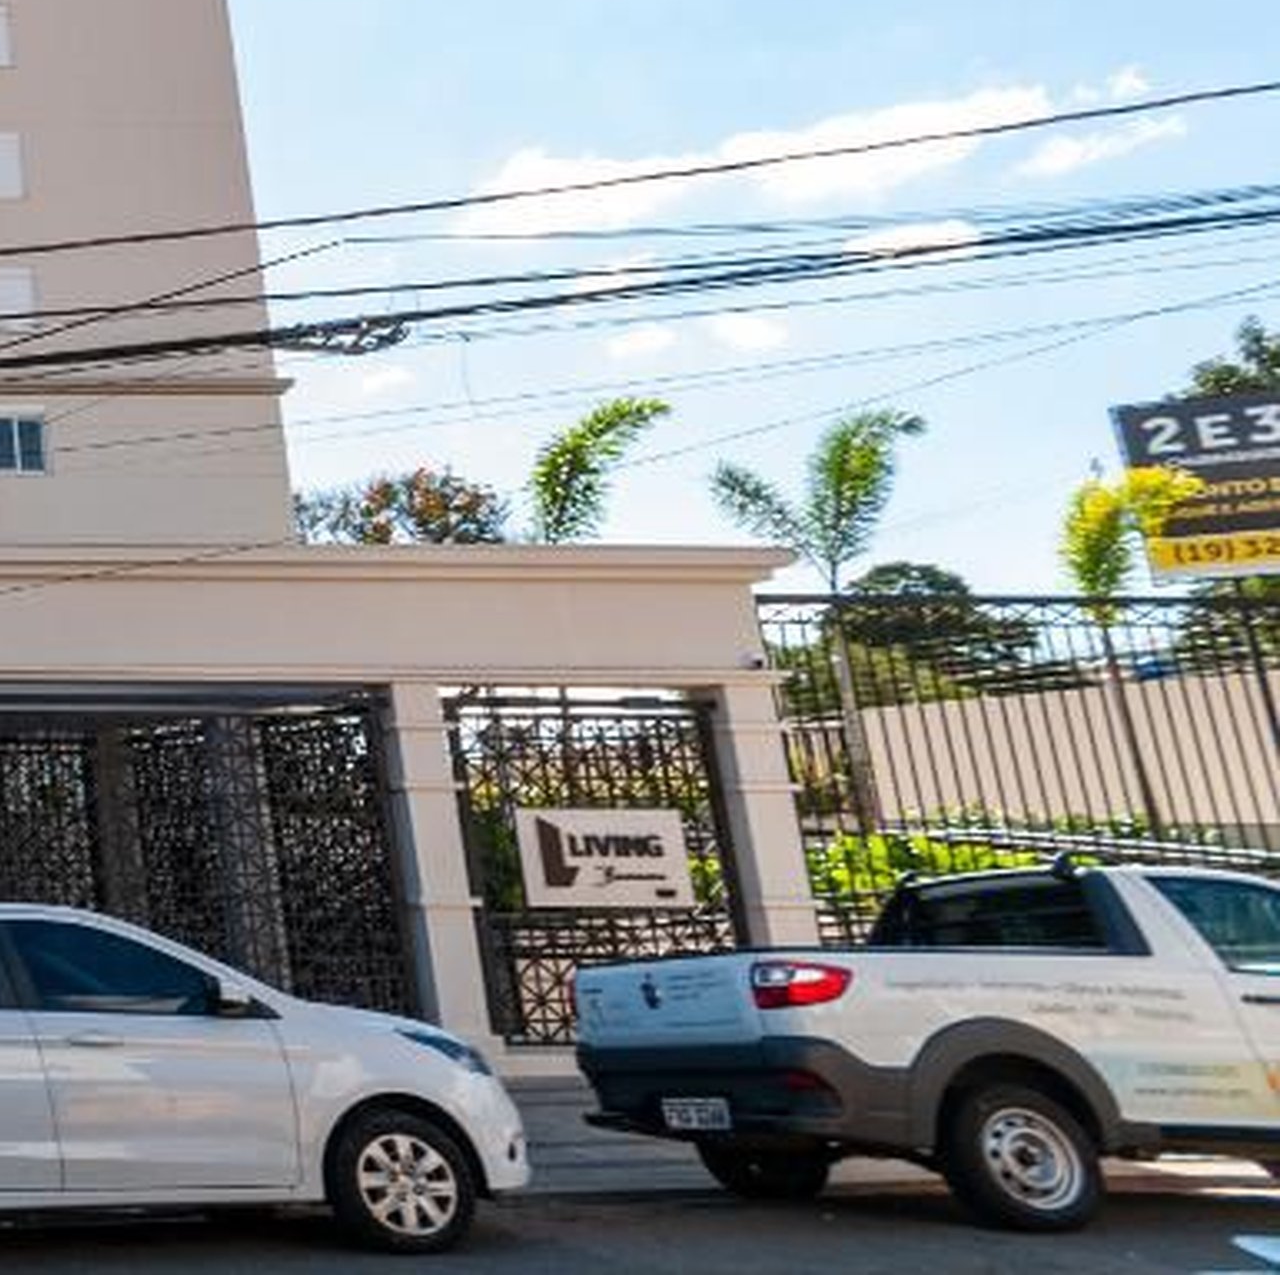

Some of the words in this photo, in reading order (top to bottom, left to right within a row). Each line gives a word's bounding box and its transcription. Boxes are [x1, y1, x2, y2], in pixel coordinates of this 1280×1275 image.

[1141, 416, 1186, 455] 2
[1194, 413, 1239, 448] E
[1244, 404, 1280, 442] 3
[1174, 539, 1234, 565] (19)
[568, 833, 664, 857] LIVING
